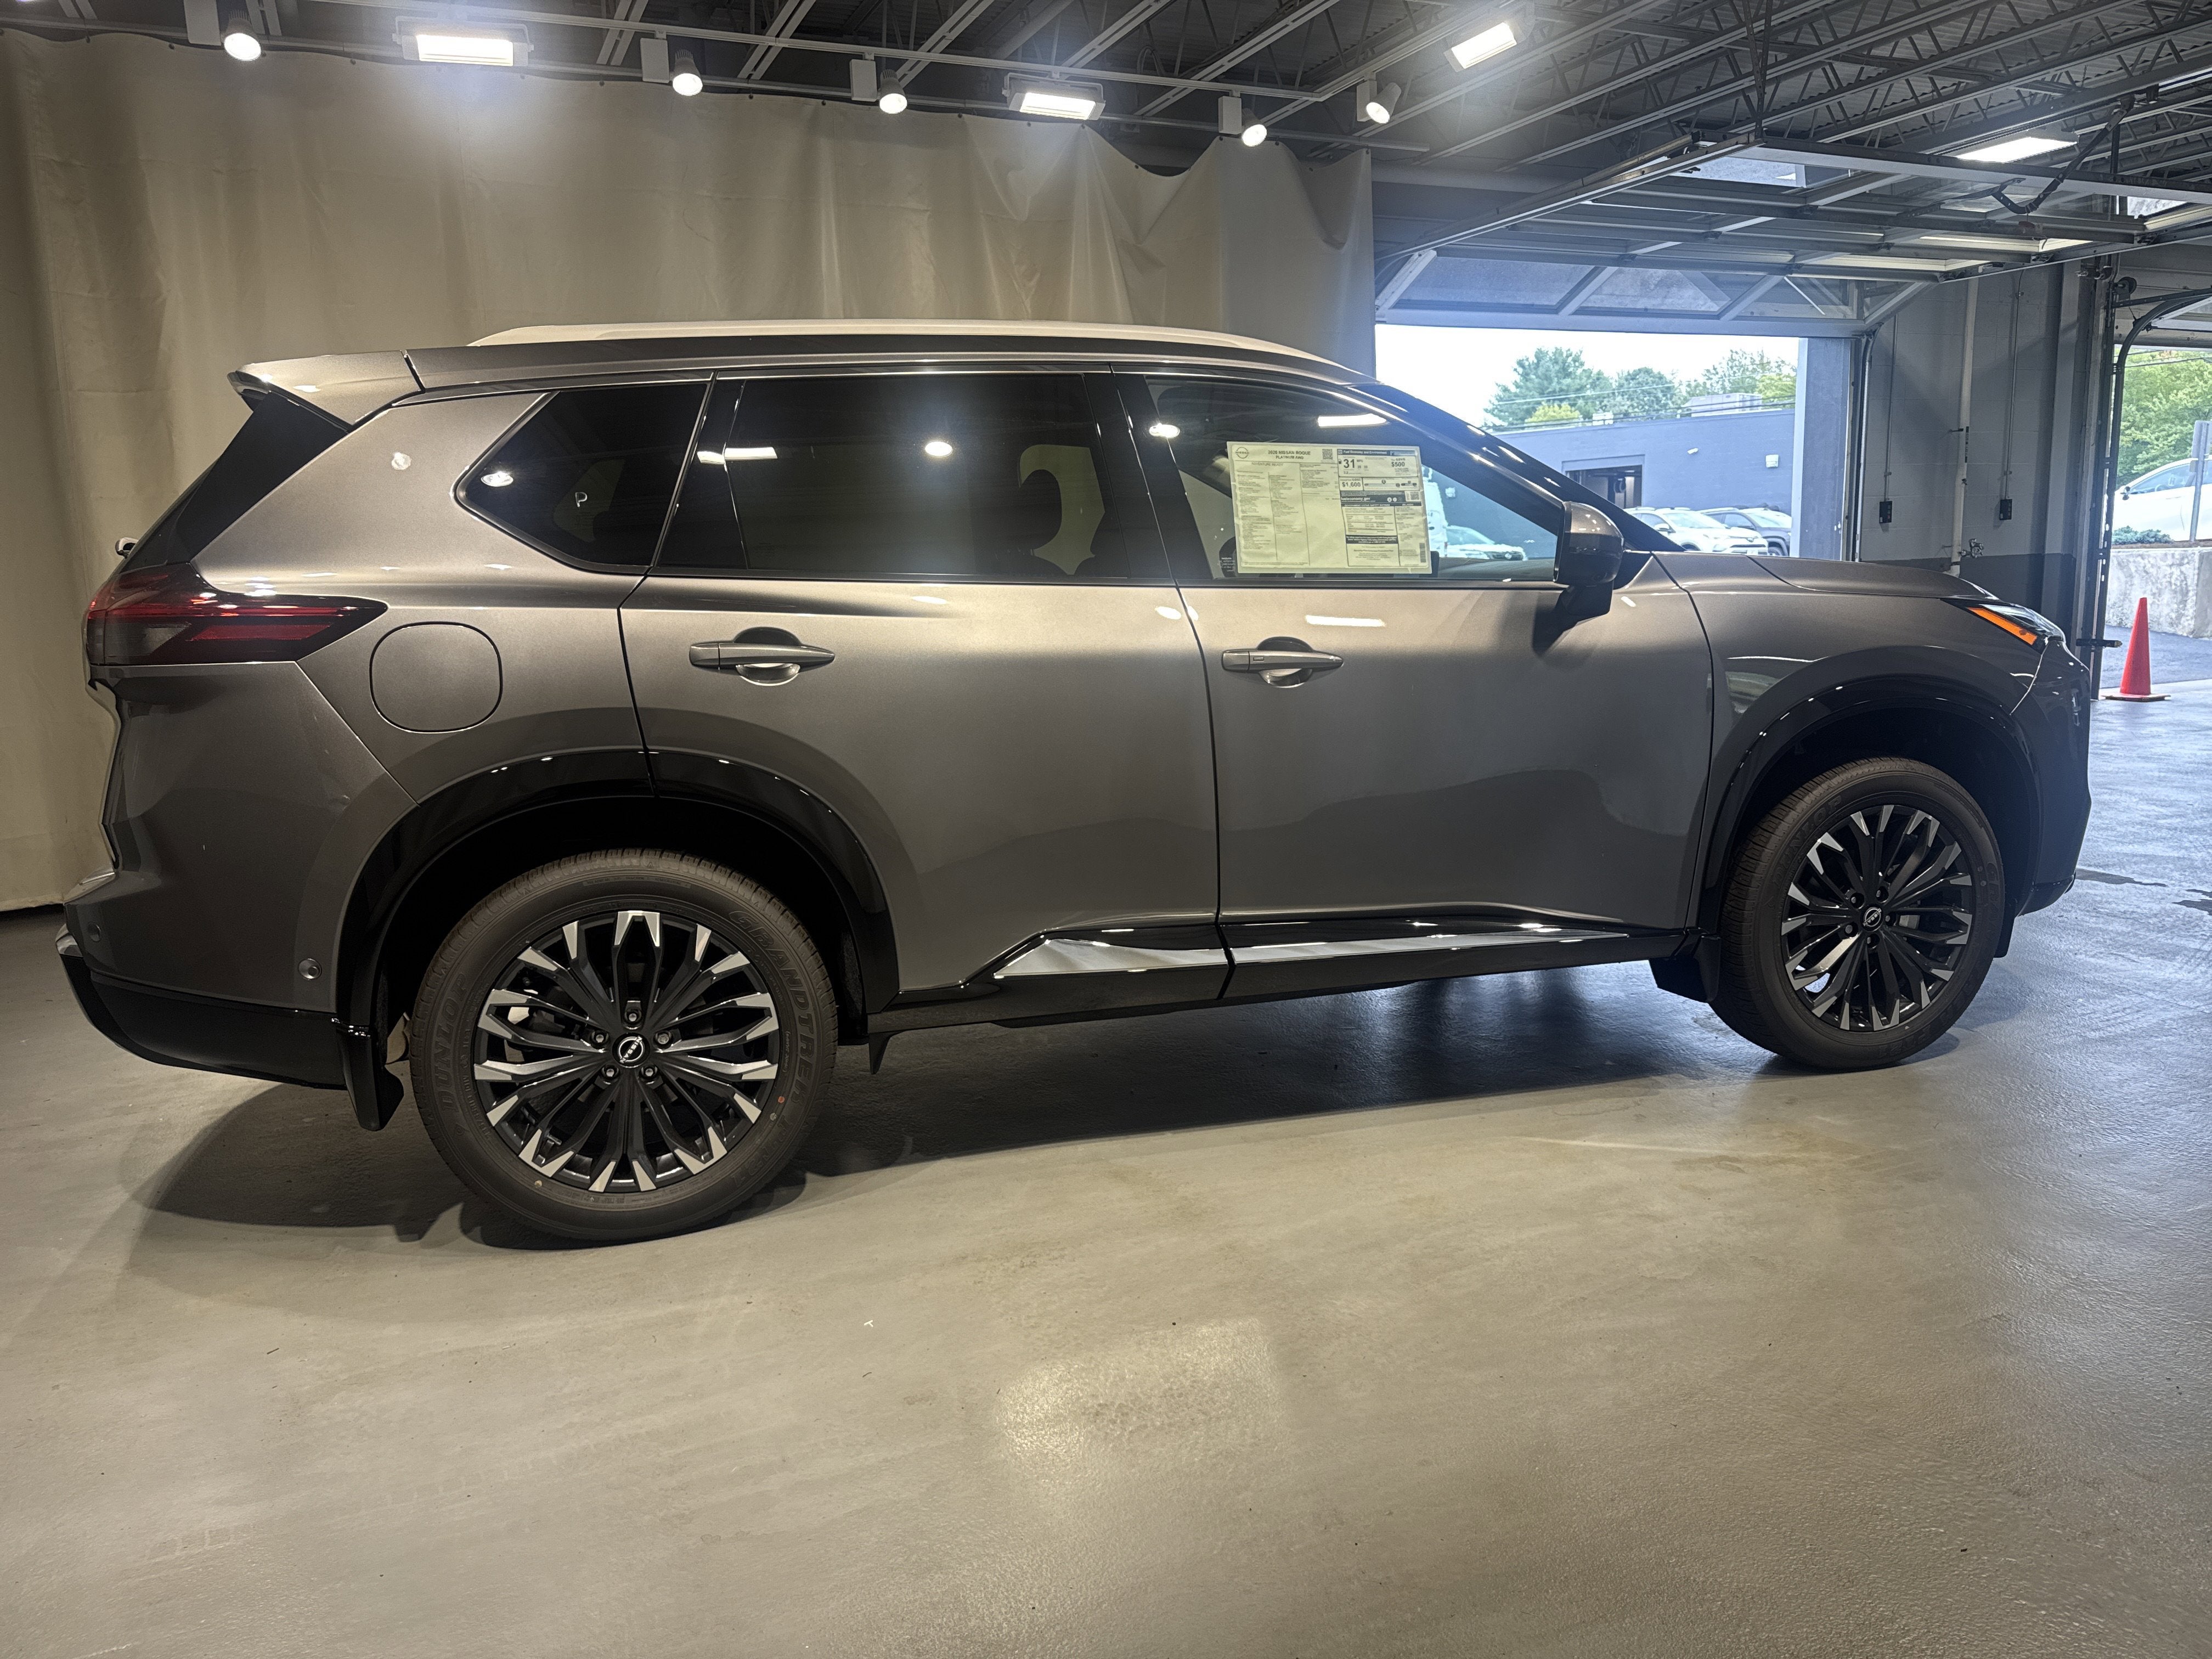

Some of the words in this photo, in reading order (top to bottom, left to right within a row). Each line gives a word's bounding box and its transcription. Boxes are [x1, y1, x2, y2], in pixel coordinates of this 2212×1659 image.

[1343, 459, 1355, 469] 31
[1863, 907, 1882, 927] NISSAN
[729, 909, 815, 1105] GRANDTREK
[434, 971, 470, 1114] DUNLOP
[619, 1035, 642, 1063] NISSAN
